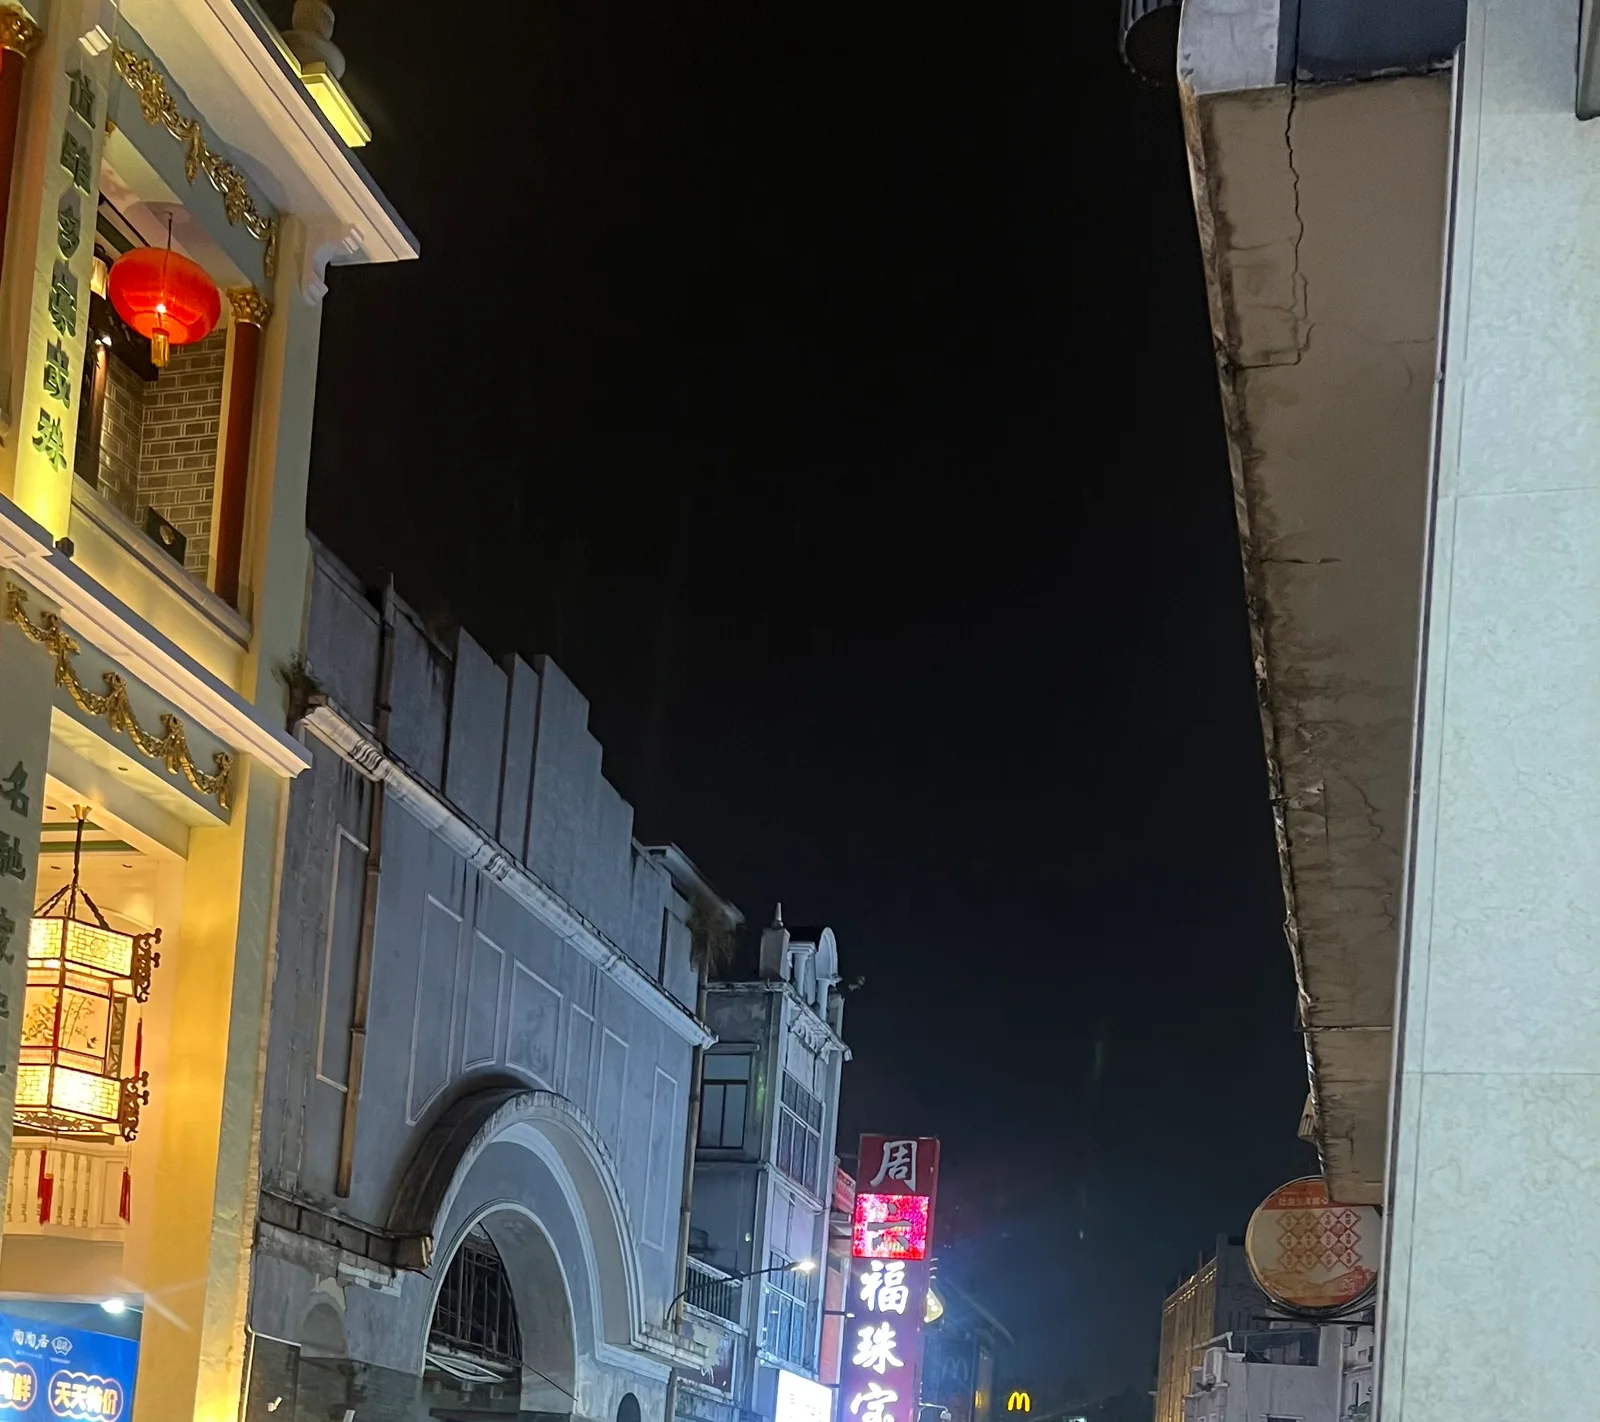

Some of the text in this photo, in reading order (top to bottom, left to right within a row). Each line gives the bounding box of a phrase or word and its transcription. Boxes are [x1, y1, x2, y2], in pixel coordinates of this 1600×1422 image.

[13, 1329, 50, 1350] 陶陶居
[54, 1380, 118, 1416] 天天特价
